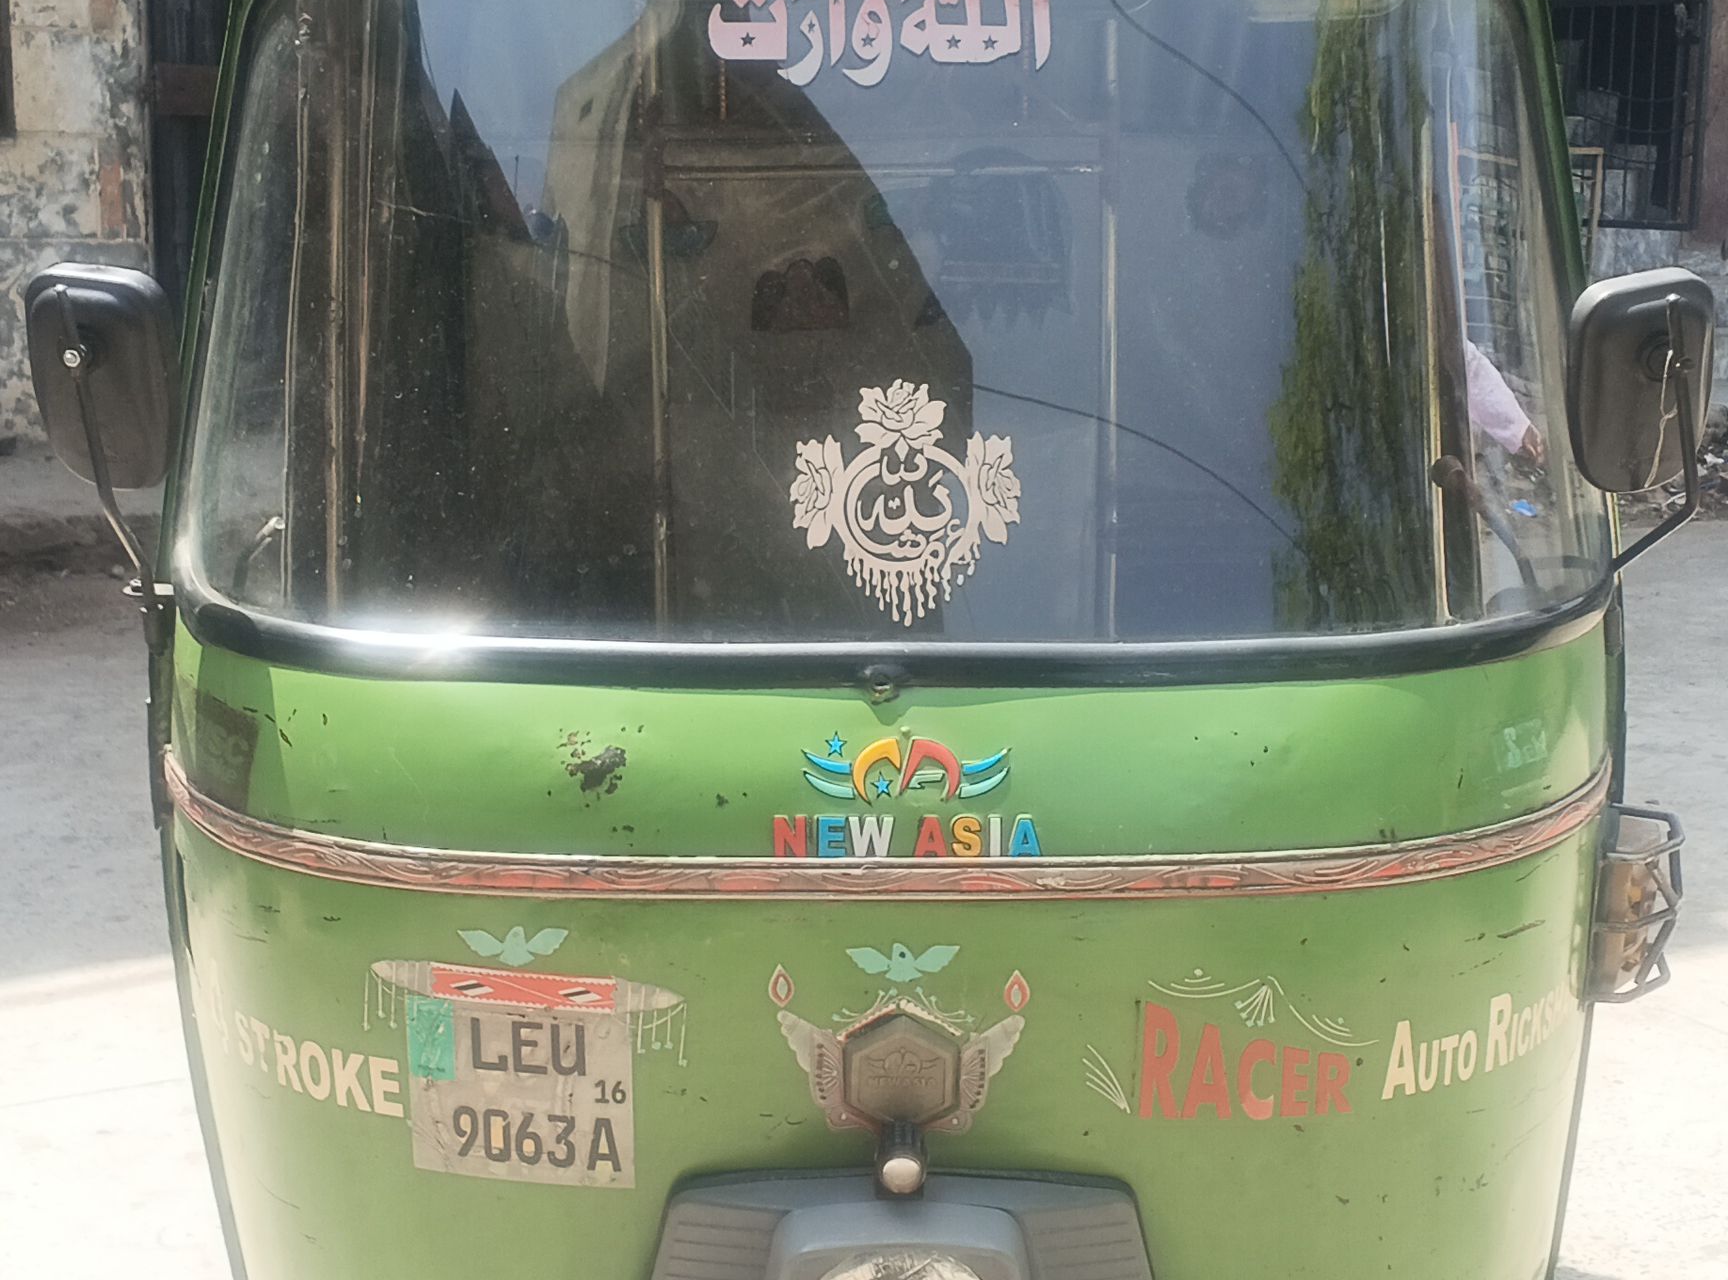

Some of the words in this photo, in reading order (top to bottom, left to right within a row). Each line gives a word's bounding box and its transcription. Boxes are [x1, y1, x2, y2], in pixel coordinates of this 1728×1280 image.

[772, 814, 895, 857] NEW
[912, 814, 1043, 857] ASIA
[234, 1010, 404, 1118] STROKE
[470, 1016, 587, 1077] LEU
[1138, 1000, 1354, 1120] RACER
[594, 1080, 627, 1104] 16
